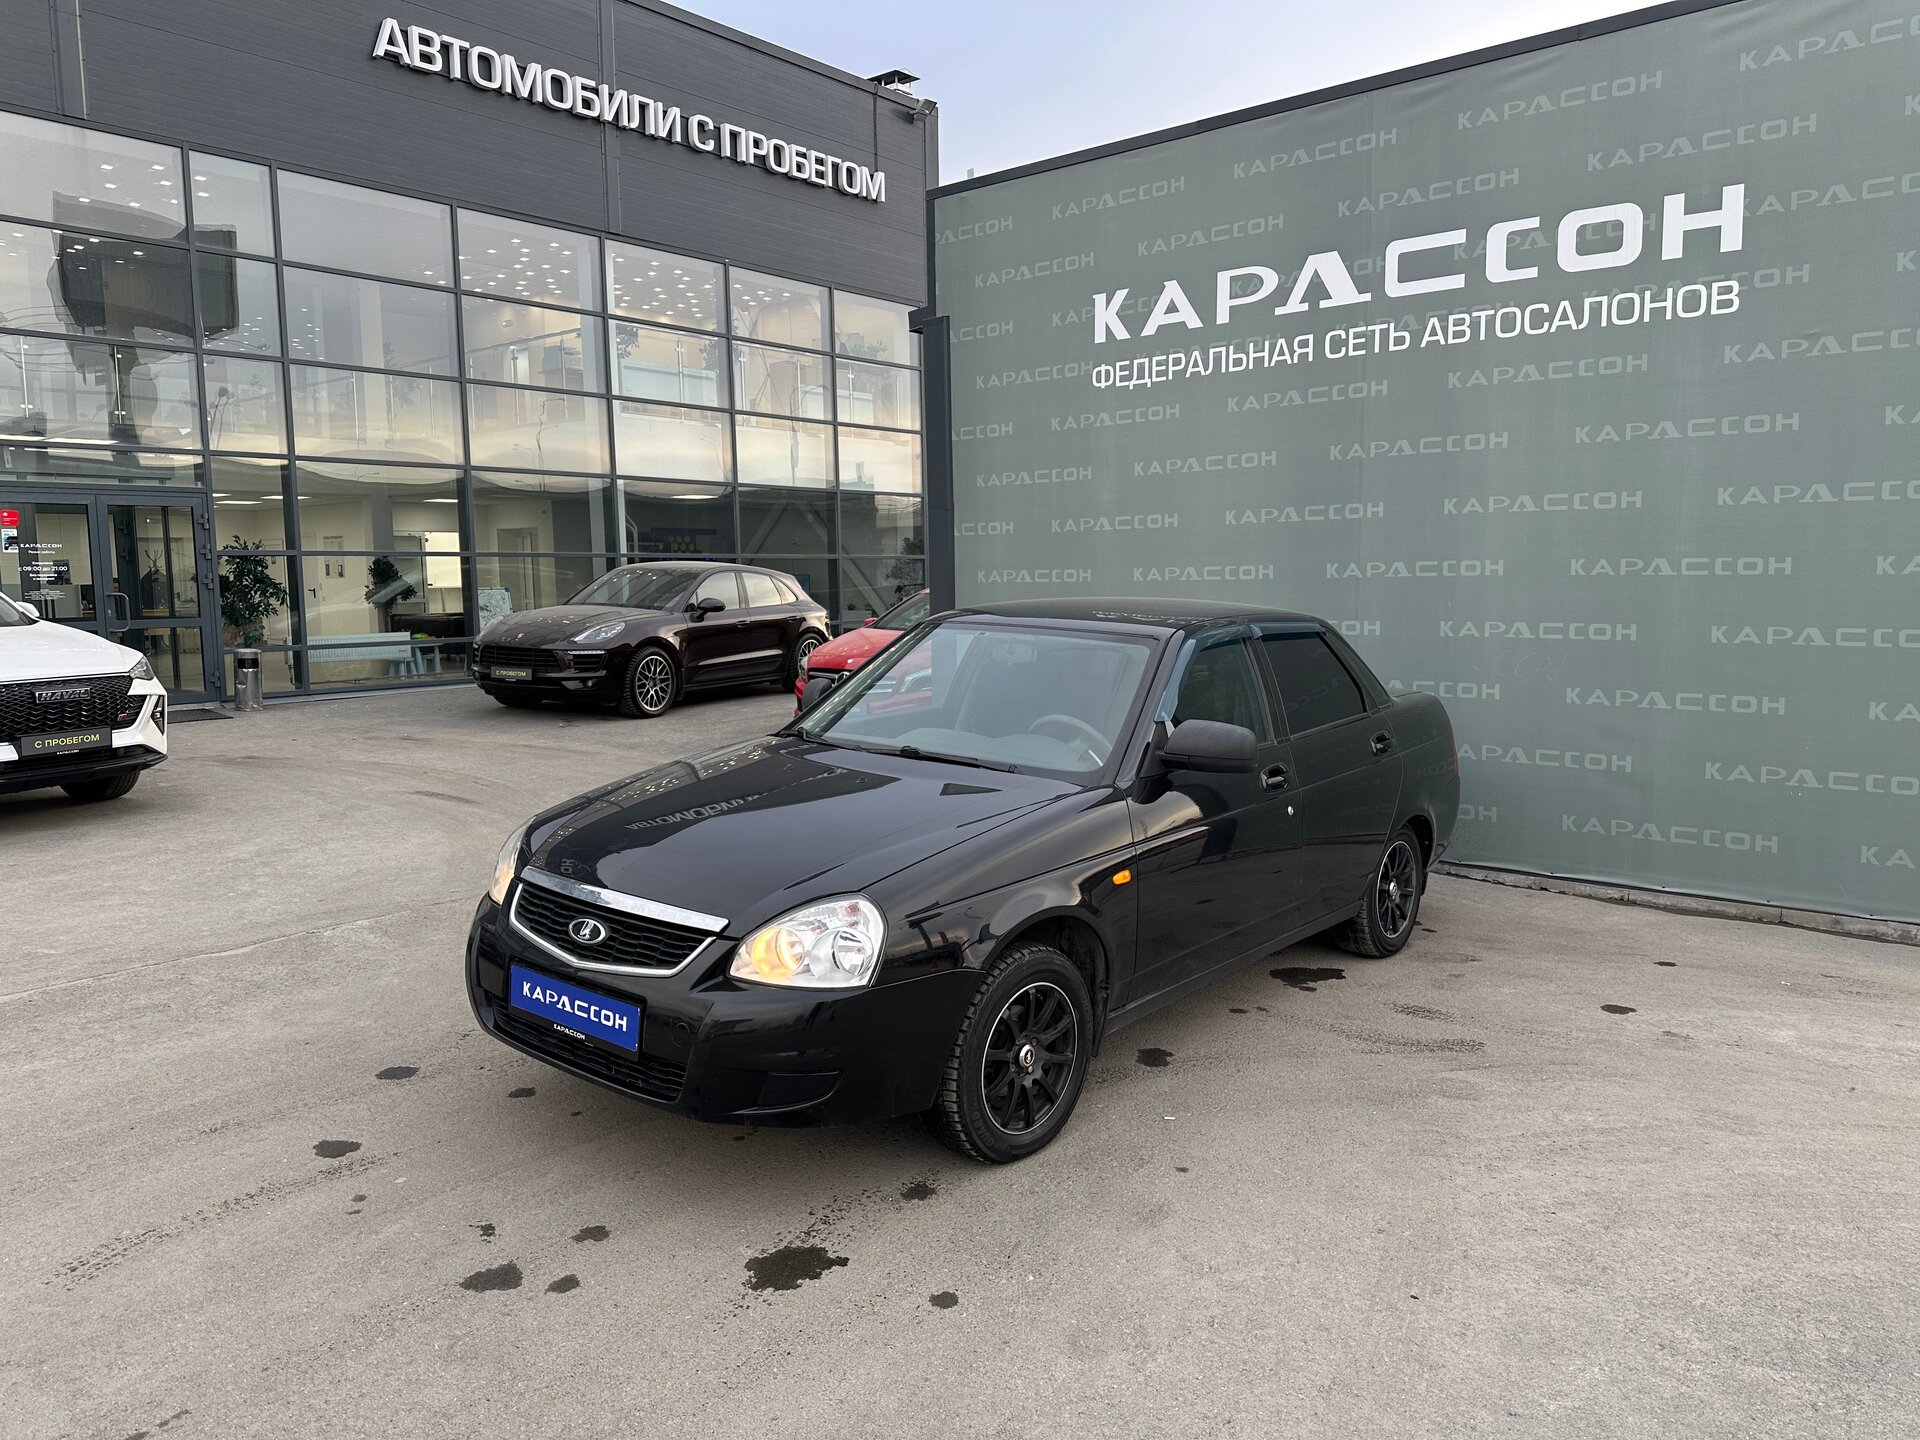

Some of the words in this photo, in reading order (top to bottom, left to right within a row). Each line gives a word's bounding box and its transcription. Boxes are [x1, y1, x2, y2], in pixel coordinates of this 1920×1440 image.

[1740, 14, 1920, 72] КАРАС
[372, 17, 681, 143] АВТОМОБИЛИ
[687, 114, 714, 152] С
[720, 123, 886, 203] ПРОБЕГОМ
[1458, 70, 1663, 130] КАРАССОН
[1233, 128, 1397, 179] КАРАССОН
[1588, 113, 1818, 171] КАРАССОН
[1053, 176, 1185, 219] КАРАССОН
[1338, 168, 1520, 218] КАРАССОН
[1744, 170, 1920, 218] АРАСС
[935, 216, 1013, 244] АССОН
[1137, 213, 1284, 257] КАРАССОН
[975, 252, 1094, 288] КАРАССОН
[1092, 183, 1745, 344] КАРАССОН
[949, 320, 1013, 344] ССОН
[1092, 333, 1314, 390] ФЕДЕРАЛЬНАЯ
[1324, 322, 1411, 359] СЕТЬ
[1420, 280, 1740, 348] АВТОСАЛОНОВ
[1723, 327, 1920, 363] КАРАСС
[976, 360, 1094, 389] КАРАССОН
[1448, 353, 1648, 389] КАРАССОН
[1228, 379, 1388, 413] КАРАССОН
[952, 422, 1013, 441] ССОН
[1051, 404, 1180, 432] КАРАССОН
[1575, 412, 1800, 445] КАРАССОН
[1329, 431, 1508, 461] КАРАССОН
[976, 466, 1092, 487] КАРАССОН
[1134, 450, 1277, 477] КАРАССОН
[1443, 490, 1642, 515] КАРАССОН
[1717, 479, 1920, 506] КАРАСС
[1051, 513, 1178, 533] КАРАССОН
[1225, 502, 1384, 525] КАРАССОН
[954, 521, 1013, 536] ССОН
[977, 568, 1092, 584] КАРАССОН
[1133, 564, 1274, 582] КАРАССОН
[1326, 559, 1504, 578] КАРАССОН
[1570, 556, 1792, 577] КАРАССОН
[1440, 620, 1637, 641] КАРАССОН
[1710, 624, 1920, 648] КАРАССО
[40, 689, 89, 701] HAVAL
[1565, 686, 1786, 715] КАРАССОН
[34, 740, 43, 748] С
[45, 733, 100, 748] ПРОБЕГОМ
[1457, 743, 1632, 773] АРАССОН
[1705, 761, 1920, 797] КАРАССО
[1562, 813, 1778, 854] КАРАССОН
[522, 980, 628, 1033] КАРАССОН
